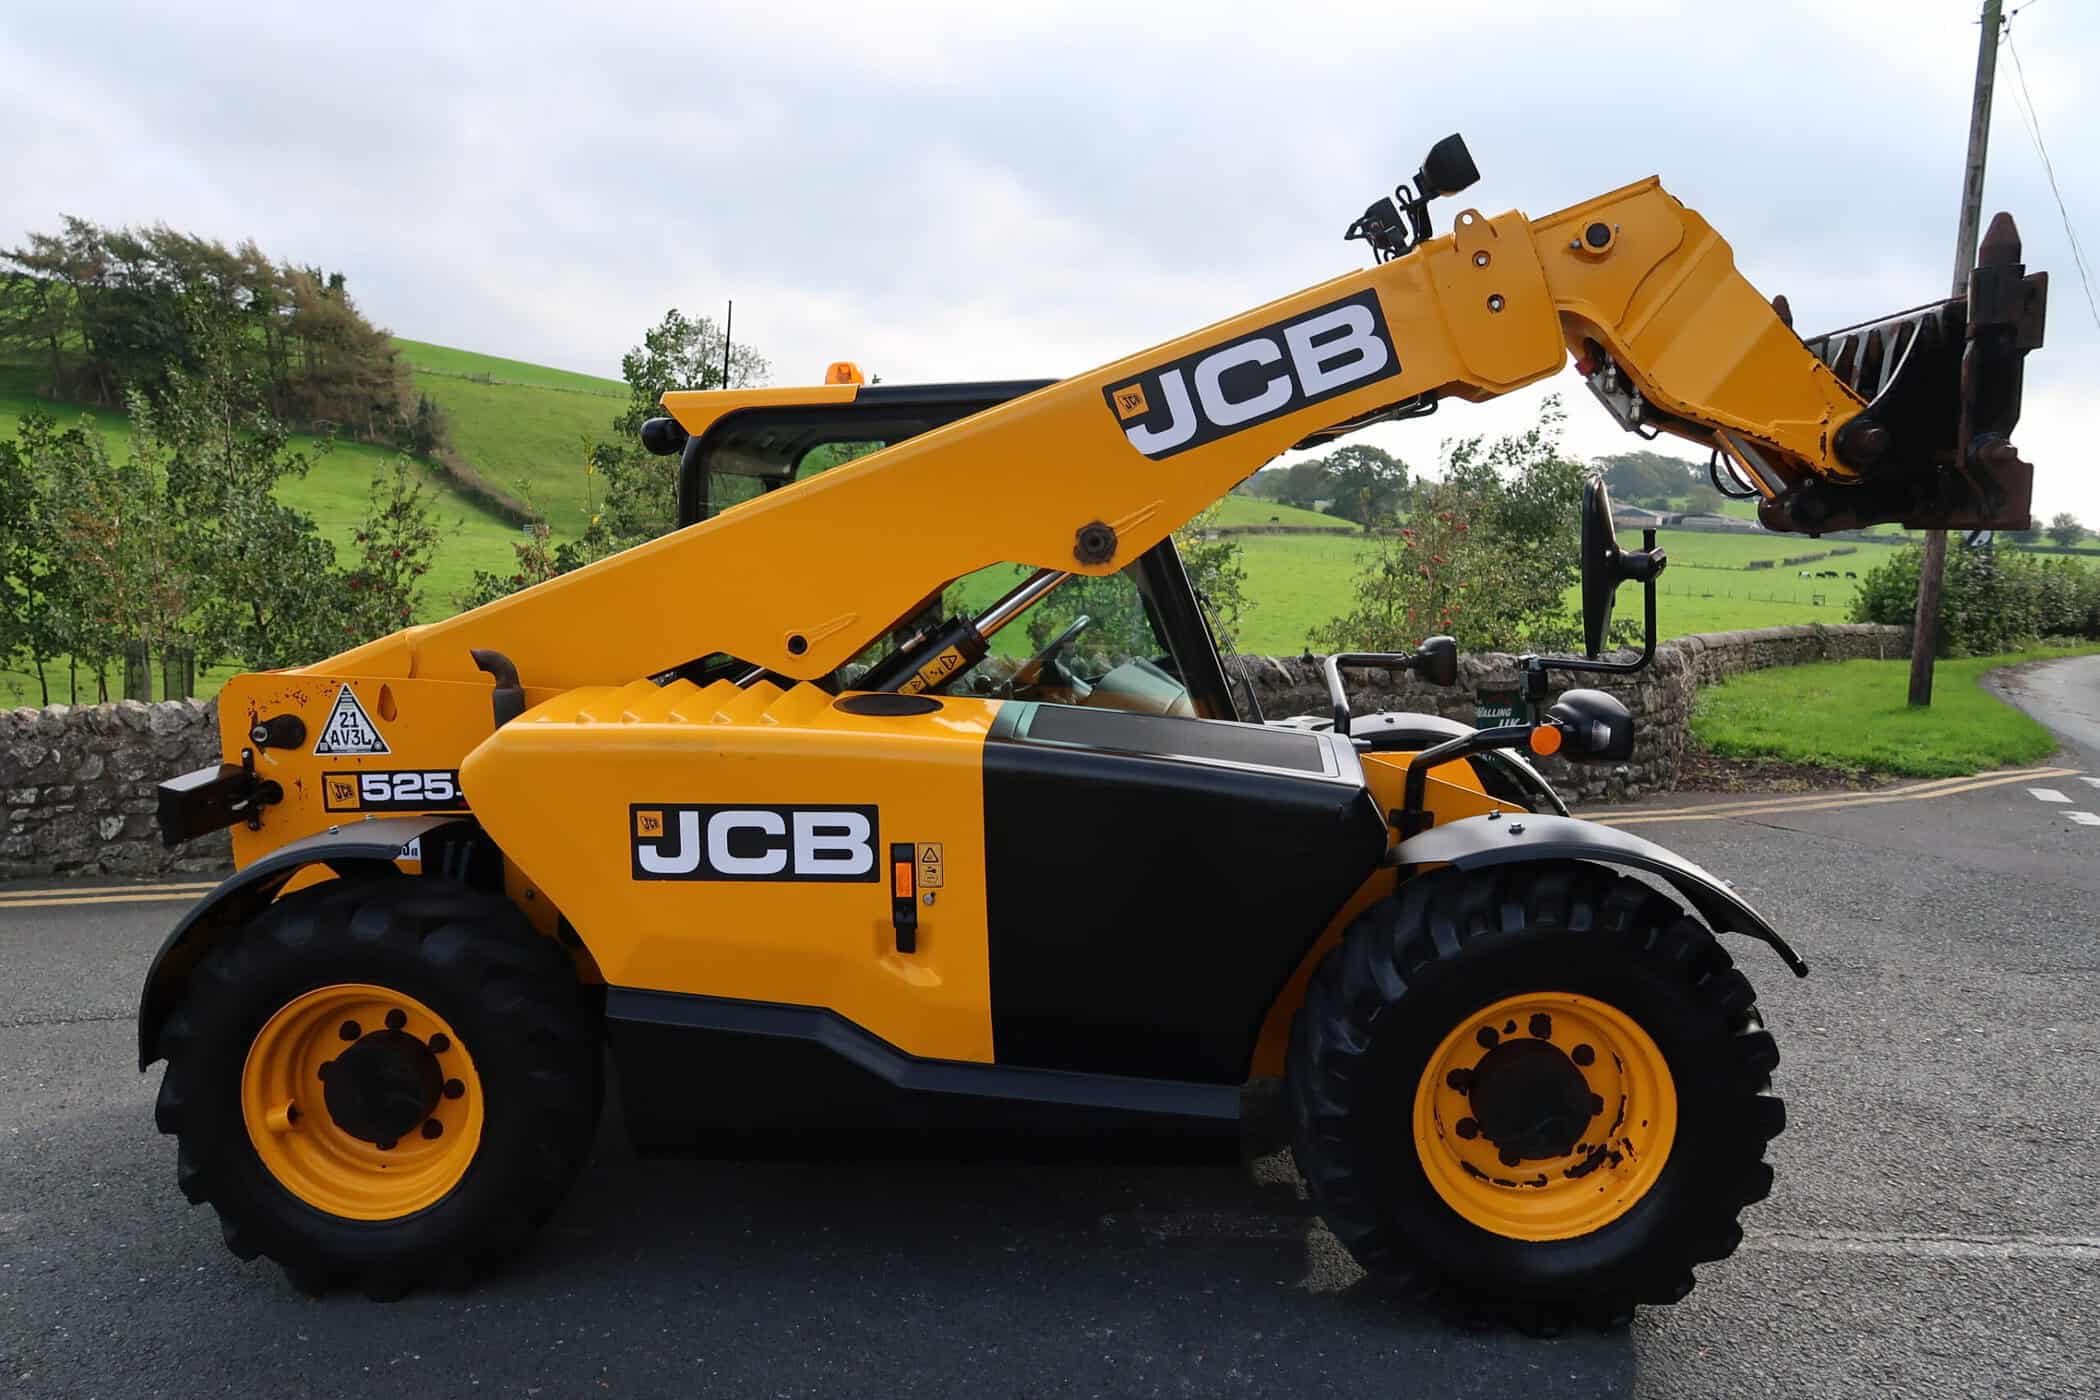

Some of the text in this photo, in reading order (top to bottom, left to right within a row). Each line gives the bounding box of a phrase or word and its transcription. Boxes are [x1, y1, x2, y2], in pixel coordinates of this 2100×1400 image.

[1125, 304, 1388, 455] JCB
[331, 729, 372, 746] AV3L
[339, 711, 359, 728] 21
[638, 810, 874, 875] JCB
